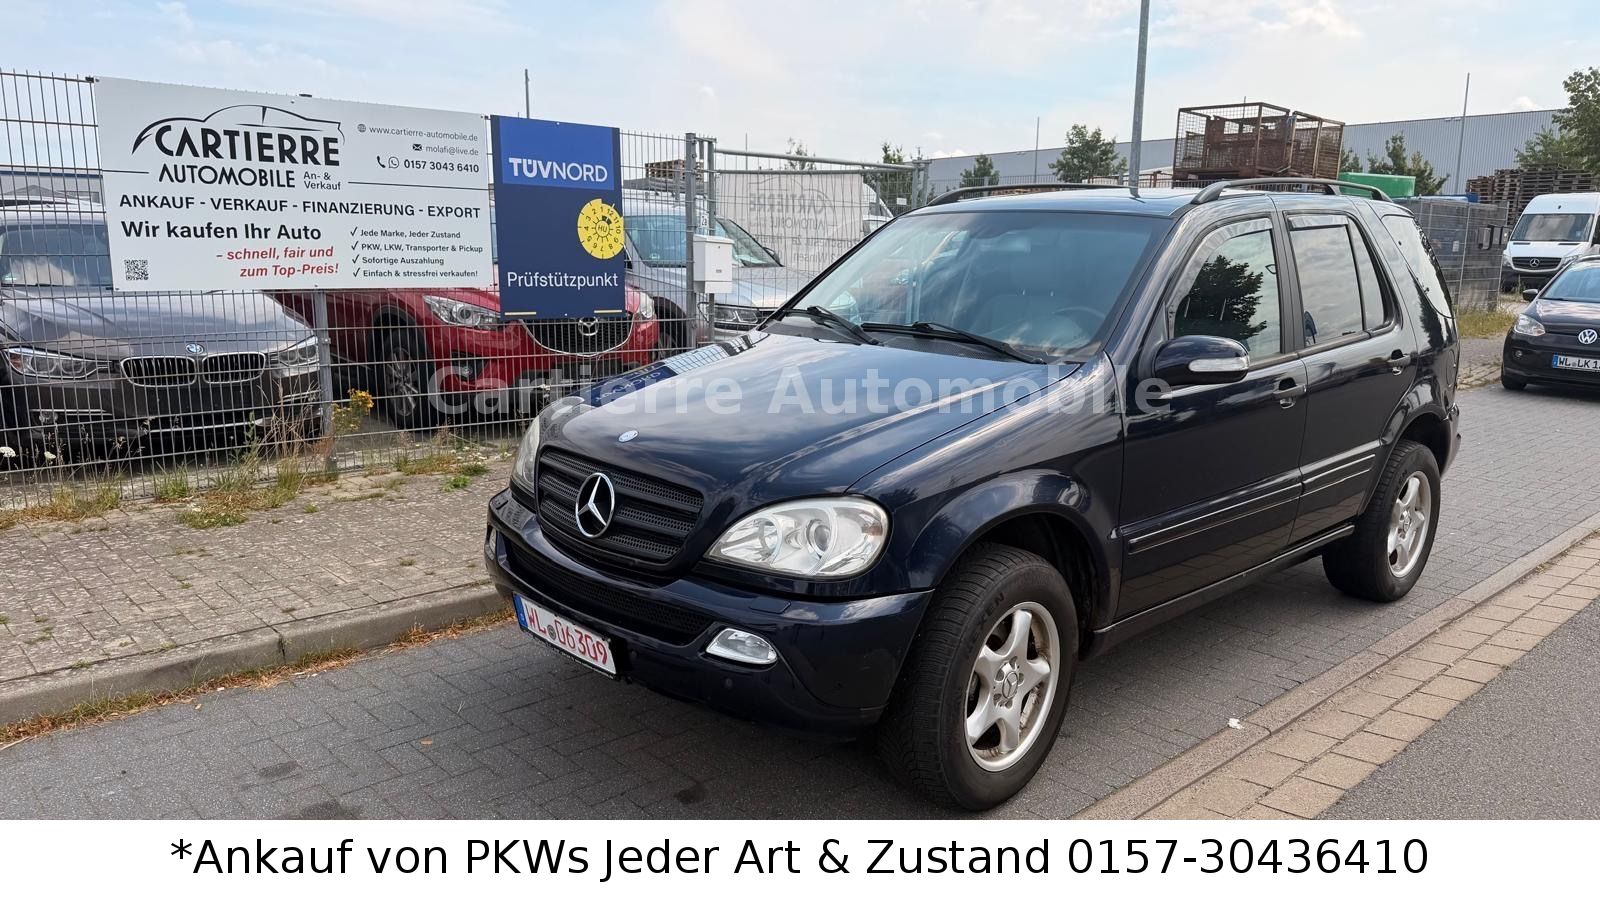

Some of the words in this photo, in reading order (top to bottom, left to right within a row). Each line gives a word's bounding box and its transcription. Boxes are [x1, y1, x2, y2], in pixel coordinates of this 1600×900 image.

[369, 126, 478, 141] www.cartierre-automobile.de
[155, 124, 340, 166] CARTIERRE
[426, 145, 479, 156] molafi@live.de
[403, 159, 427, 169] 0157
[429, 161, 455, 171] 3043
[457, 163, 480, 173] 6410
[159, 163, 295, 188] AUTOMOBILE
[303, 171, 321, 180] An-
[323, 172, 331, 181] &
[303, 180, 341, 190] Verkauf
[119, 194, 195, 209] ANKAUF
[210, 198, 288, 212] VERKAUF
[302, 201, 415, 216] FINANZIERUNG
[427, 206, 481, 219] EXPORT
[121, 221, 160, 238] Wir
[166, 221, 238, 239] kaufen
[245, 223, 271, 239] Ihr
[276, 224, 322, 240] Auto
[360, 229, 379, 237] Jede
[380, 230, 407, 238] Marke,
[409, 230, 429, 238] Jeder
[431, 231, 461, 239] Zustand
[597, 224, 608, 232] HU
[226, 248, 280, 261] schnell,
[283, 247, 306, 259] fair
[309, 246, 334, 258] und
[361, 243, 382, 252] PKW,
[384, 243, 404, 252] LKW,
[405, 244, 450, 253] Transporter
[459, 245, 483, 253] Pickup
[362, 257, 399, 266] Sofortige
[400, 257, 445, 266] Auszahlung
[239, 266, 268, 277] zum
[272, 263, 339, 278] Top-Preis!
[363, 269, 393, 277] Einfach
[402, 269, 438, 277] stressfrei
[440, 269, 478, 277] verkaufen!
[507, 271, 619, 290] Prüfstützpunkt
[1558, 357, 1571, 367] WL
[1577, 359, 1591, 368] LK
[1592, 360, 1600, 369] 1
[525, 602, 547, 635] WL
[554, 619, 608, 666] 06309
